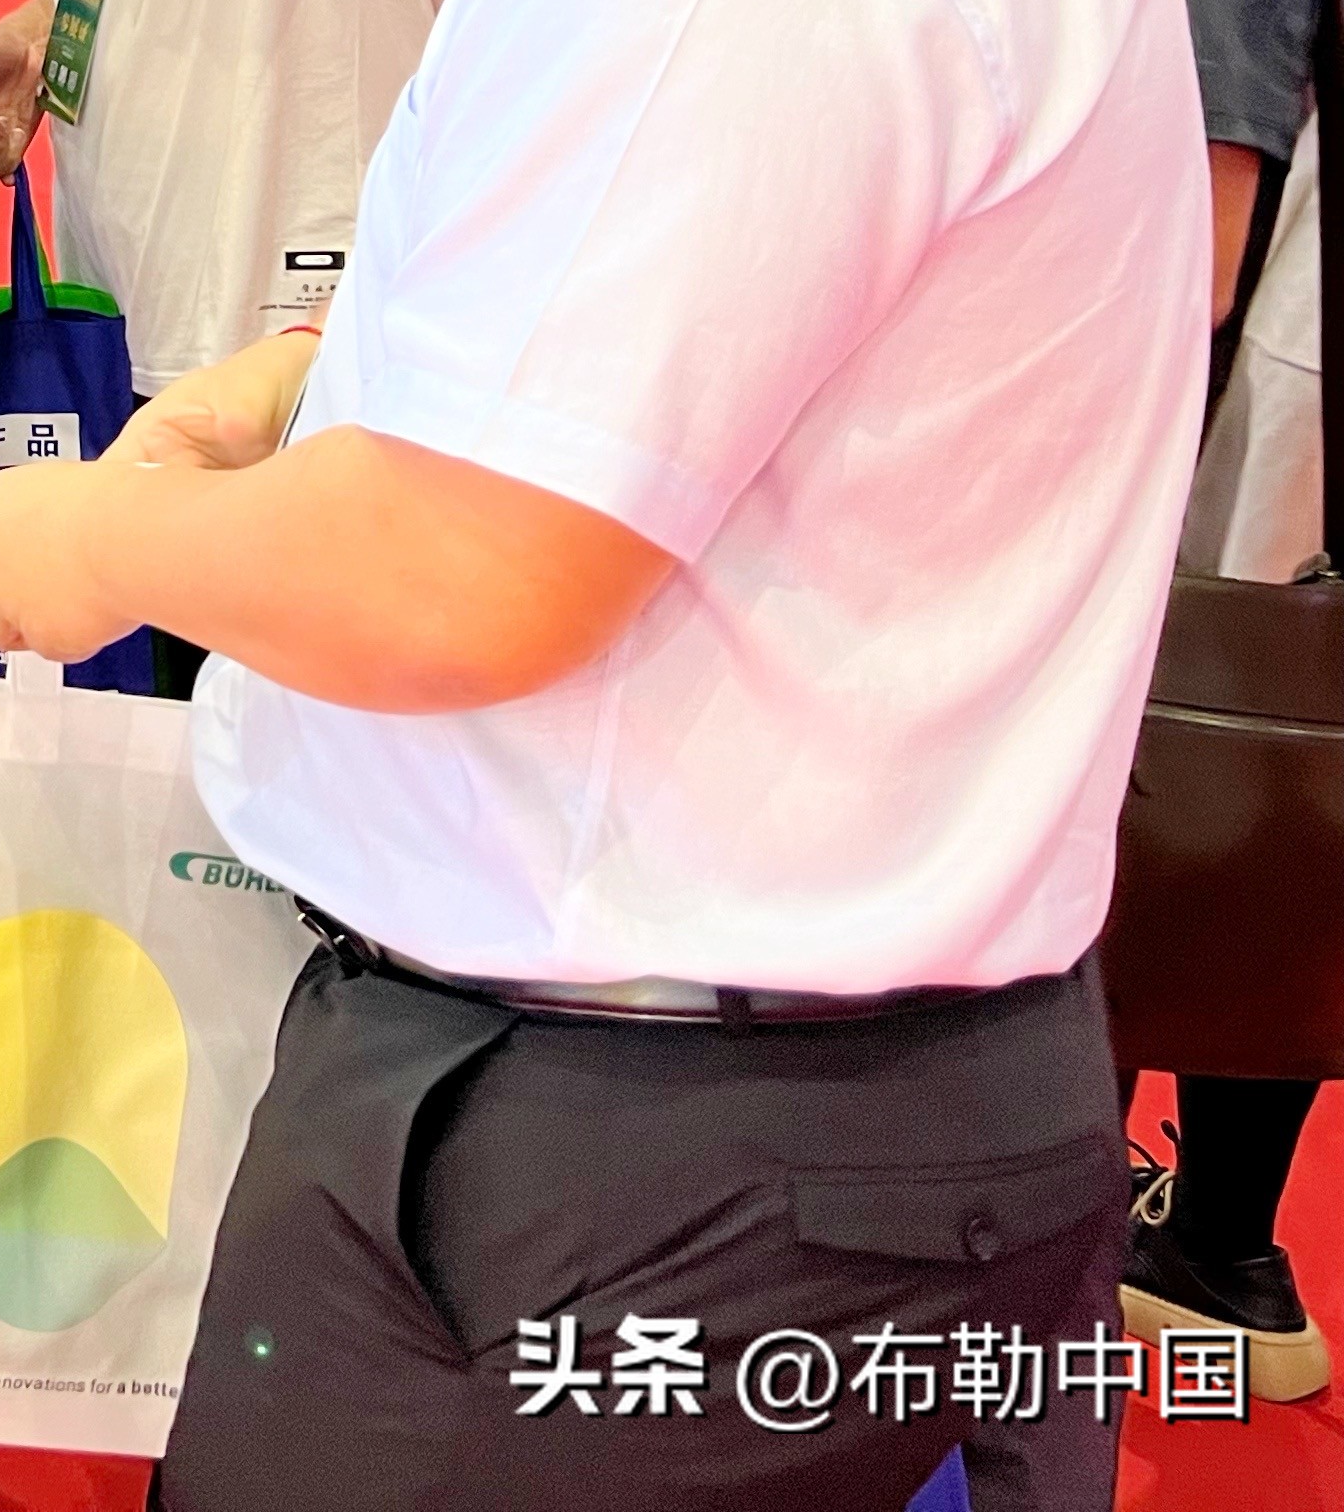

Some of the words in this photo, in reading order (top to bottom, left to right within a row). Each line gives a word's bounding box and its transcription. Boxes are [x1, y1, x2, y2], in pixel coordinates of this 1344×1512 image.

[201, 862, 285, 893] BÜHL
[90, 1377, 114, 1394] for
[116, 1381, 126, 1395] a
[131, 1379, 179, 1399] bette
